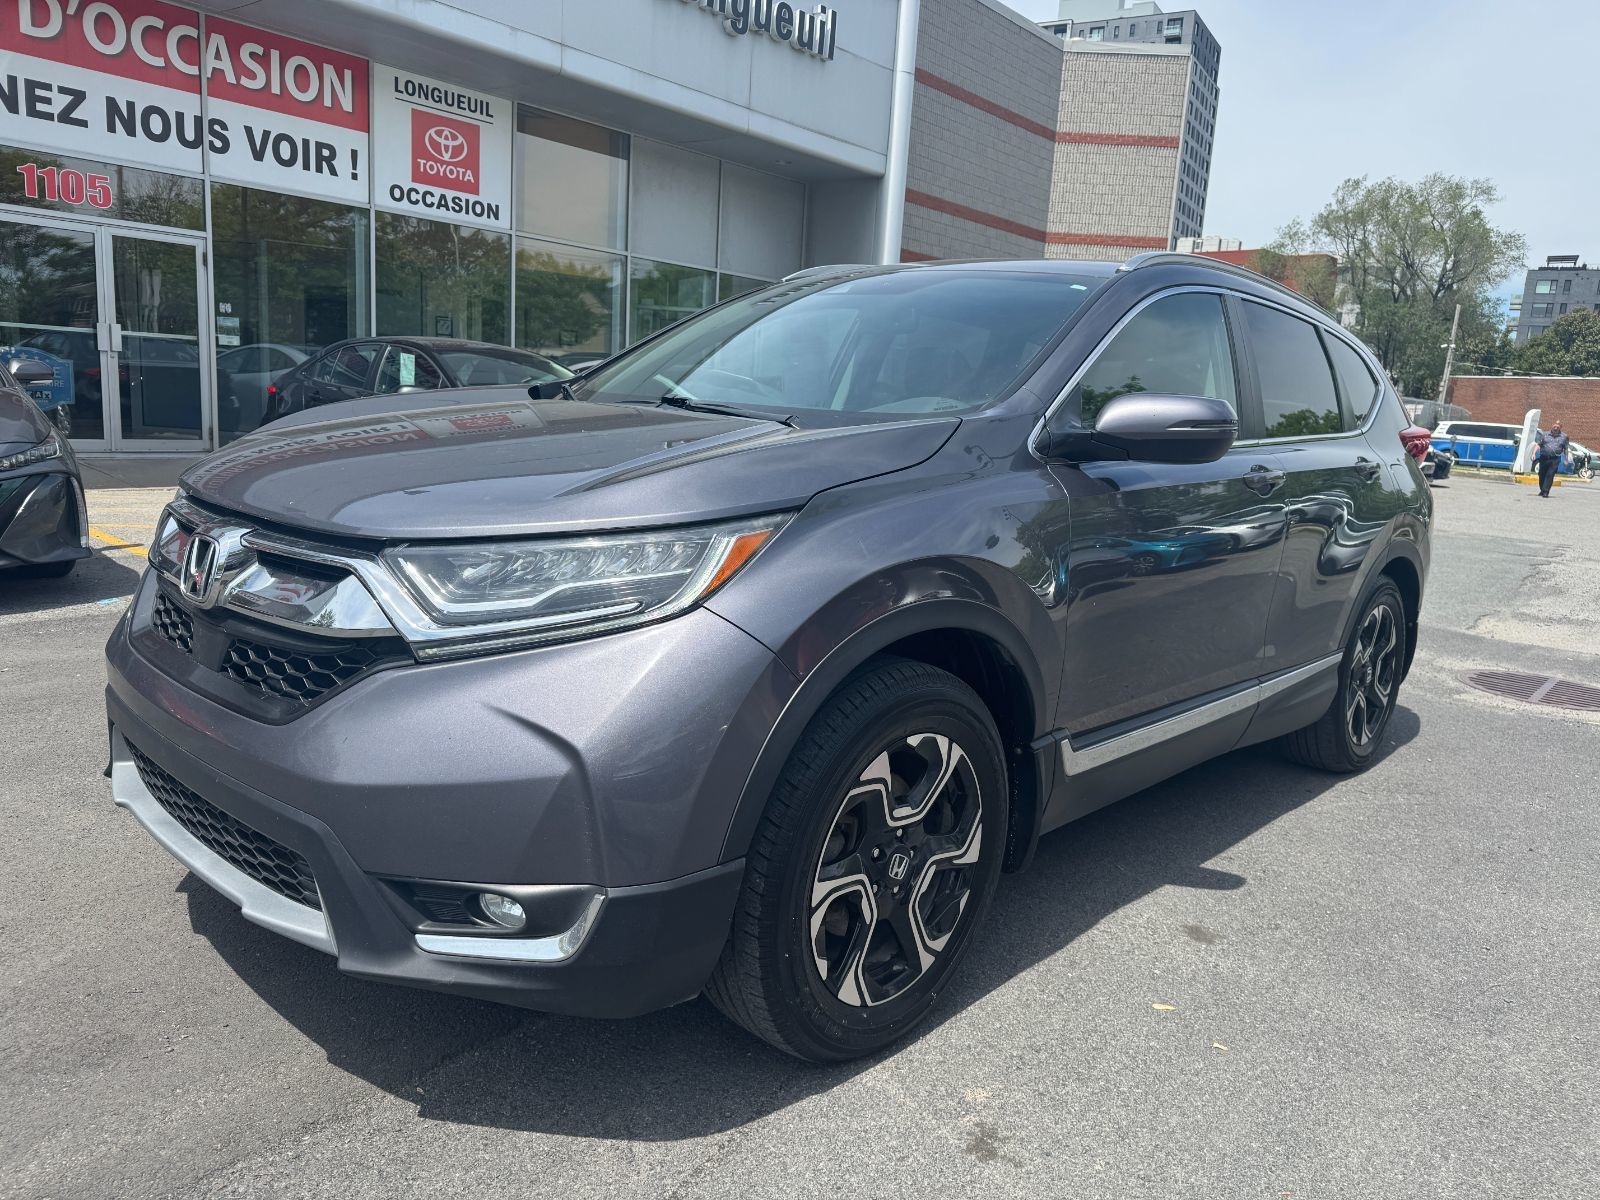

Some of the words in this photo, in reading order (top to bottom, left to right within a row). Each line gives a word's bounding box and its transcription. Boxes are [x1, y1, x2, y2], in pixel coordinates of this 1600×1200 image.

[18, 0, 353, 113] D'OCCASION
[394, 76, 494, 118] LONGUEUIL
[105, 95, 231, 155] NOUS
[243, 124, 339, 177] VOIR
[16, 162, 113, 209] 1105
[417, 158, 475, 183] TOYOTA
[389, 183, 500, 221] OCCASION
